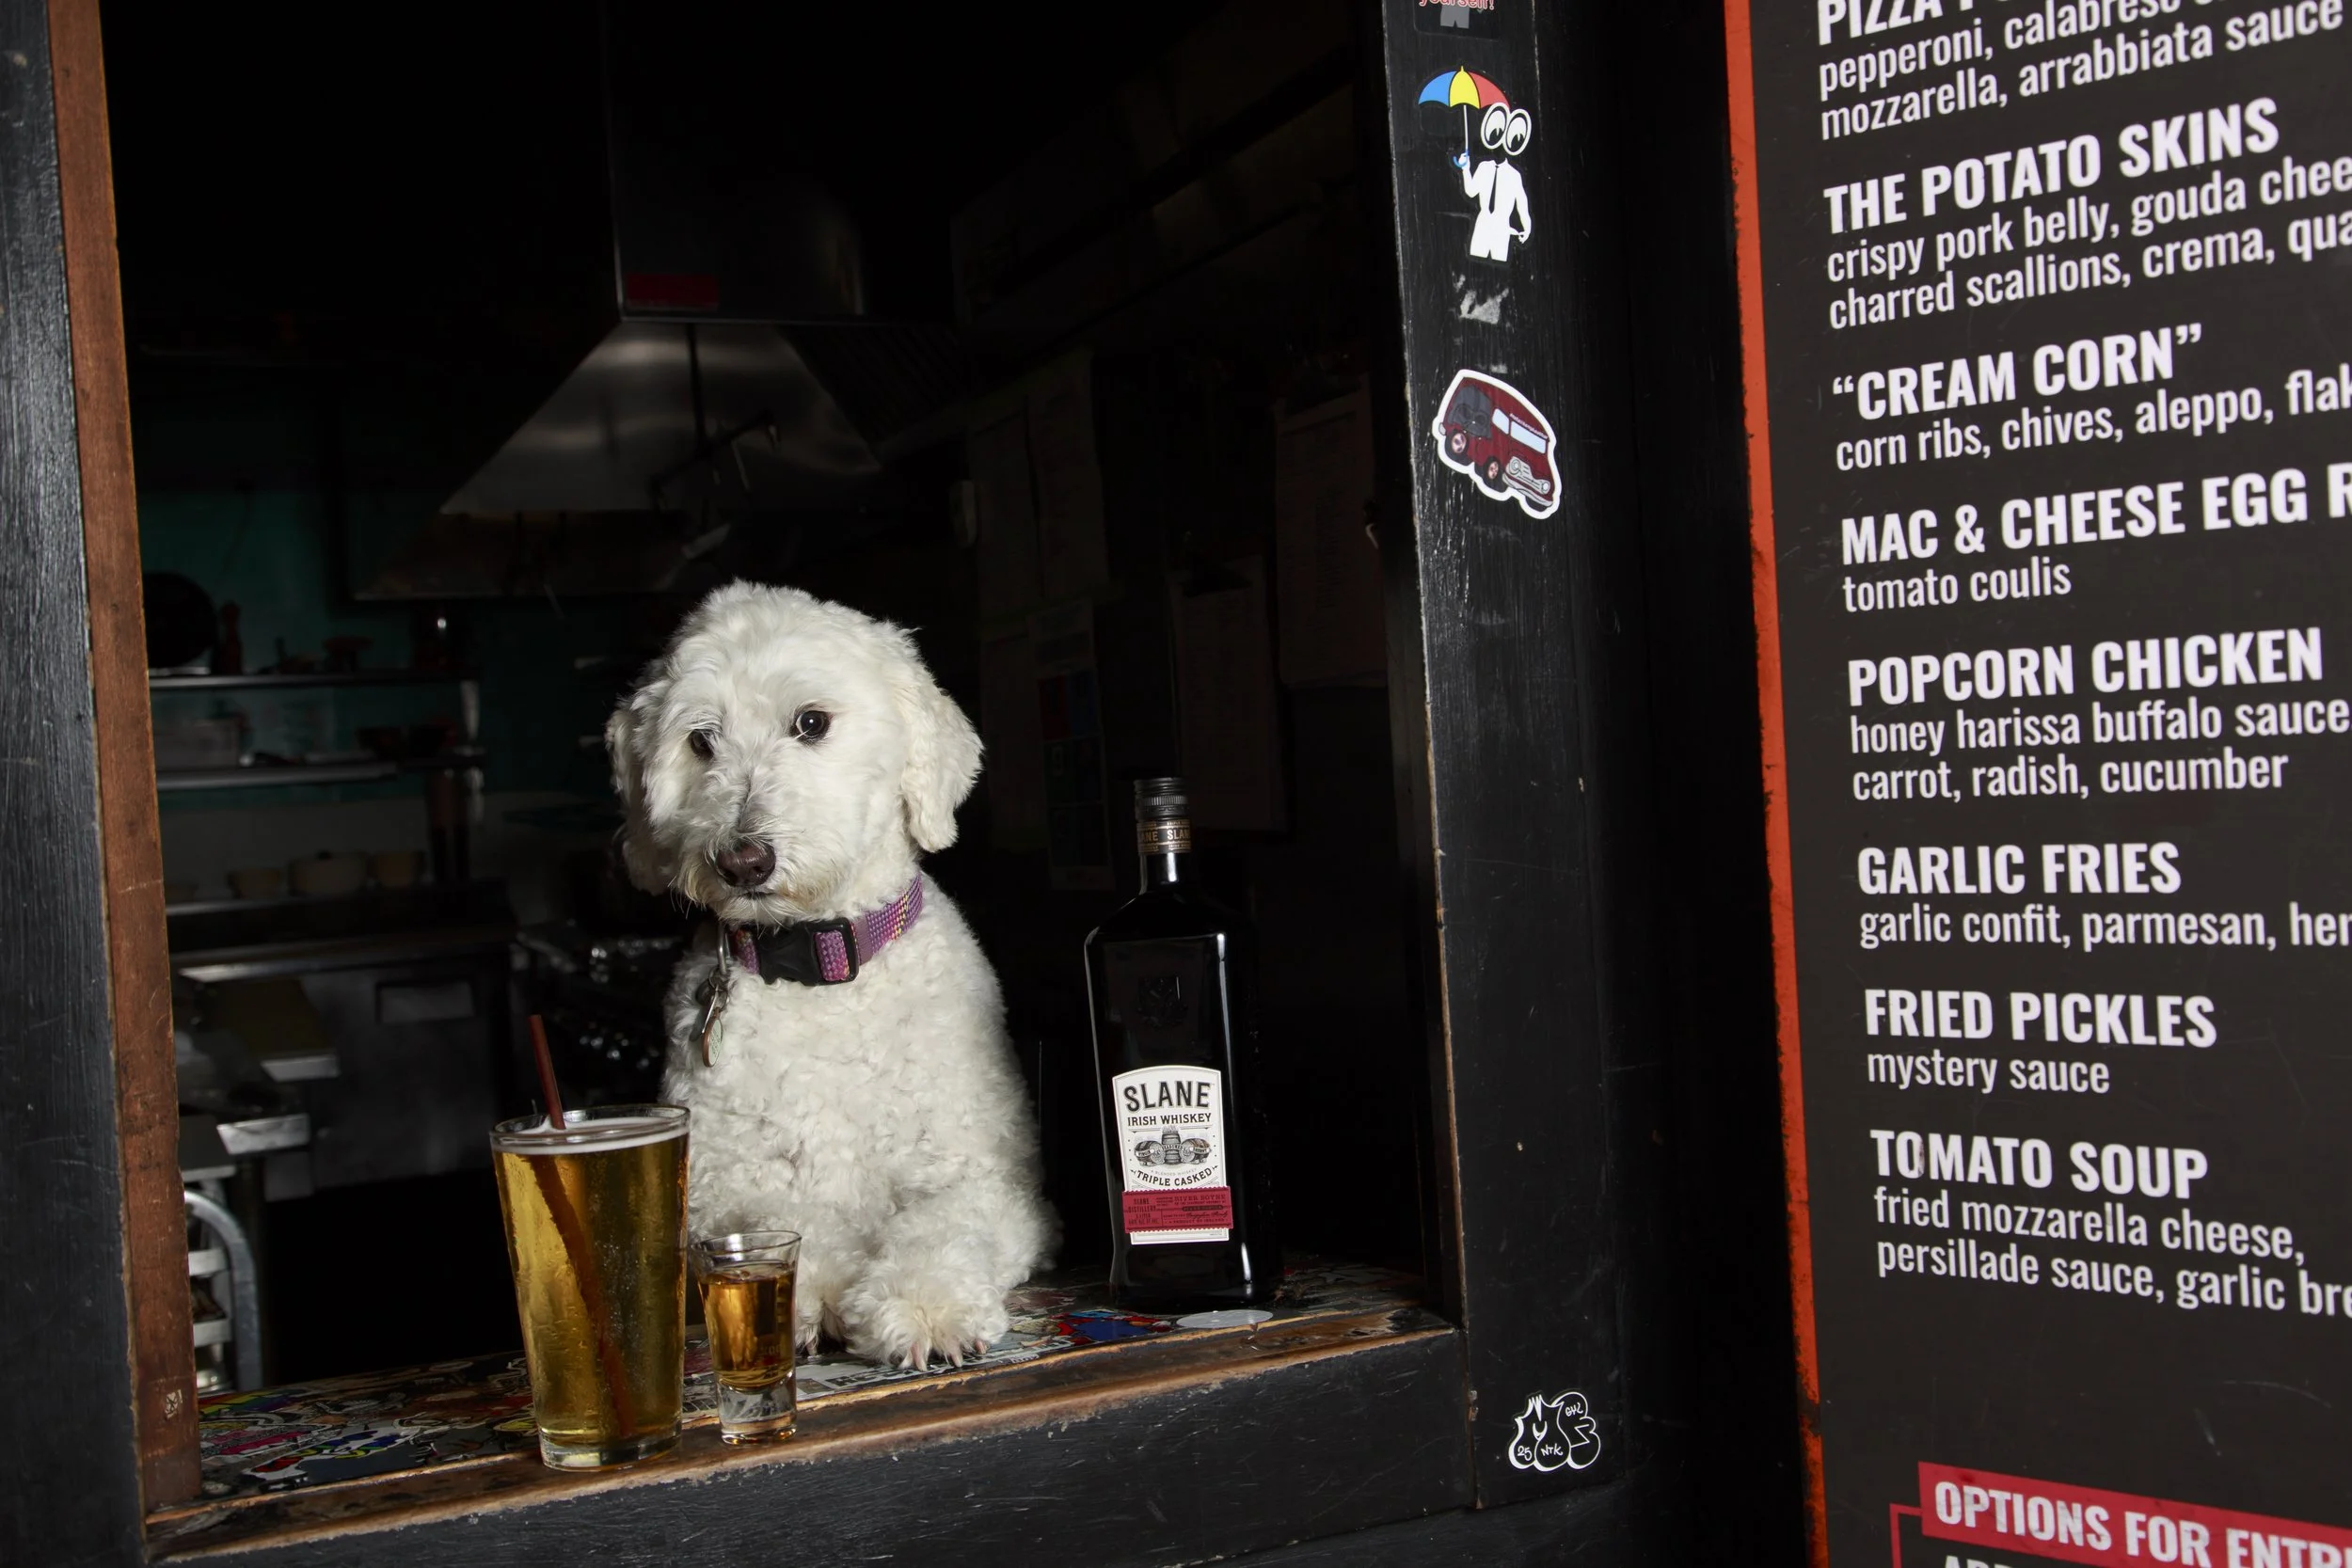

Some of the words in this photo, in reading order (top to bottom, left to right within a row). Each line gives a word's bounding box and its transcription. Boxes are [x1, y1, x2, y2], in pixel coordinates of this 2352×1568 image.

[1820, 26, 1994, 102] pepperoni,
[1821, 73, 2008, 141] mozzarella,
[2019, 22, 2213, 97] arrabbiata
[2225, 0, 2343, 51] sauce
[1823, 173, 1907, 234] THE
[1921, 134, 2101, 216] POTATO
[2119, 97, 2280, 178] SKINS
[1827, 237, 1925, 282] crispy
[1936, 212, 2014, 272] pork
[2024, 195, 2120, 248] belly,
[2131, 169, 2247, 237] gouda
[1830, 270, 1955, 330] charred
[1966, 252, 2131, 308] scallions,
[2142, 227, 2275, 278] crema,
[1833, 351, 2016, 420] “CREAM
[2033, 322, 2201, 396] CORN”
[1836, 434, 1907, 471] corn
[1918, 417, 1991, 461] ribs,
[2001, 404, 2123, 451] chives,
[2135, 387, 2274, 437] aleppo,
[1841, 509, 1938, 565] MAC
[1954, 504, 1986, 555] &
[2001, 481, 2186, 549] CHEESE
[2201, 467, 2308, 531] EGG
[1842, 568, 1959, 612] tomato
[1970, 555, 2072, 602] coulis
[1848, 644, 2074, 707] POPCORN
[2091, 626, 2323, 693] CHICKEN
[1851, 715, 1946, 757] honey
[1956, 706, 2081, 749] harissa
[2092, 695, 2222, 743] buffalo
[2235, 699, 2350, 737] sauce
[1853, 761, 1962, 803] carrot,
[1972, 752, 2089, 800] radish,
[2100, 746, 2289, 793] cucumber
[1858, 844, 2026, 895] GARLIC
[2042, 841, 2182, 894] FRIES
[1860, 902, 1951, 950] garlic
[1963, 903, 2071, 949] confit,
[2082, 912, 2277, 953] parmesan,
[1865, 989, 1994, 1039] FRIED
[2010, 991, 2217, 1048] PICKLES
[1123, 1081, 1211, 1113] SLANE
[1867, 1049, 1998, 1094] mystery
[2010, 1059, 2110, 1094] sauce
[1127, 1116, 1157, 1127] IRISH
[1160, 1112, 1212, 1125] WHISKEY
[1136, 1169, 1171, 1186] TRIPLE
[1174, 1167, 1213, 1186] CASKED
[1869, 1129, 2053, 1189] TOMATO
[2070, 1141, 2208, 1199] SOUP
[1873, 1185, 1949, 1228] fried
[1962, 1201, 2148, 1246] mozzarella
[2161, 1208, 2304, 1266] cheese,
[1878, 1238, 2040, 1285] persillade
[2051, 1258, 2164, 1304] sauce,
[2176, 1263, 2285, 1310] garlic
[1934, 1481, 2112, 1551] OPTIONS
[2124, 1511, 2212, 1568] FOR
[2226, 1528, 2352, 1568] ENTR
